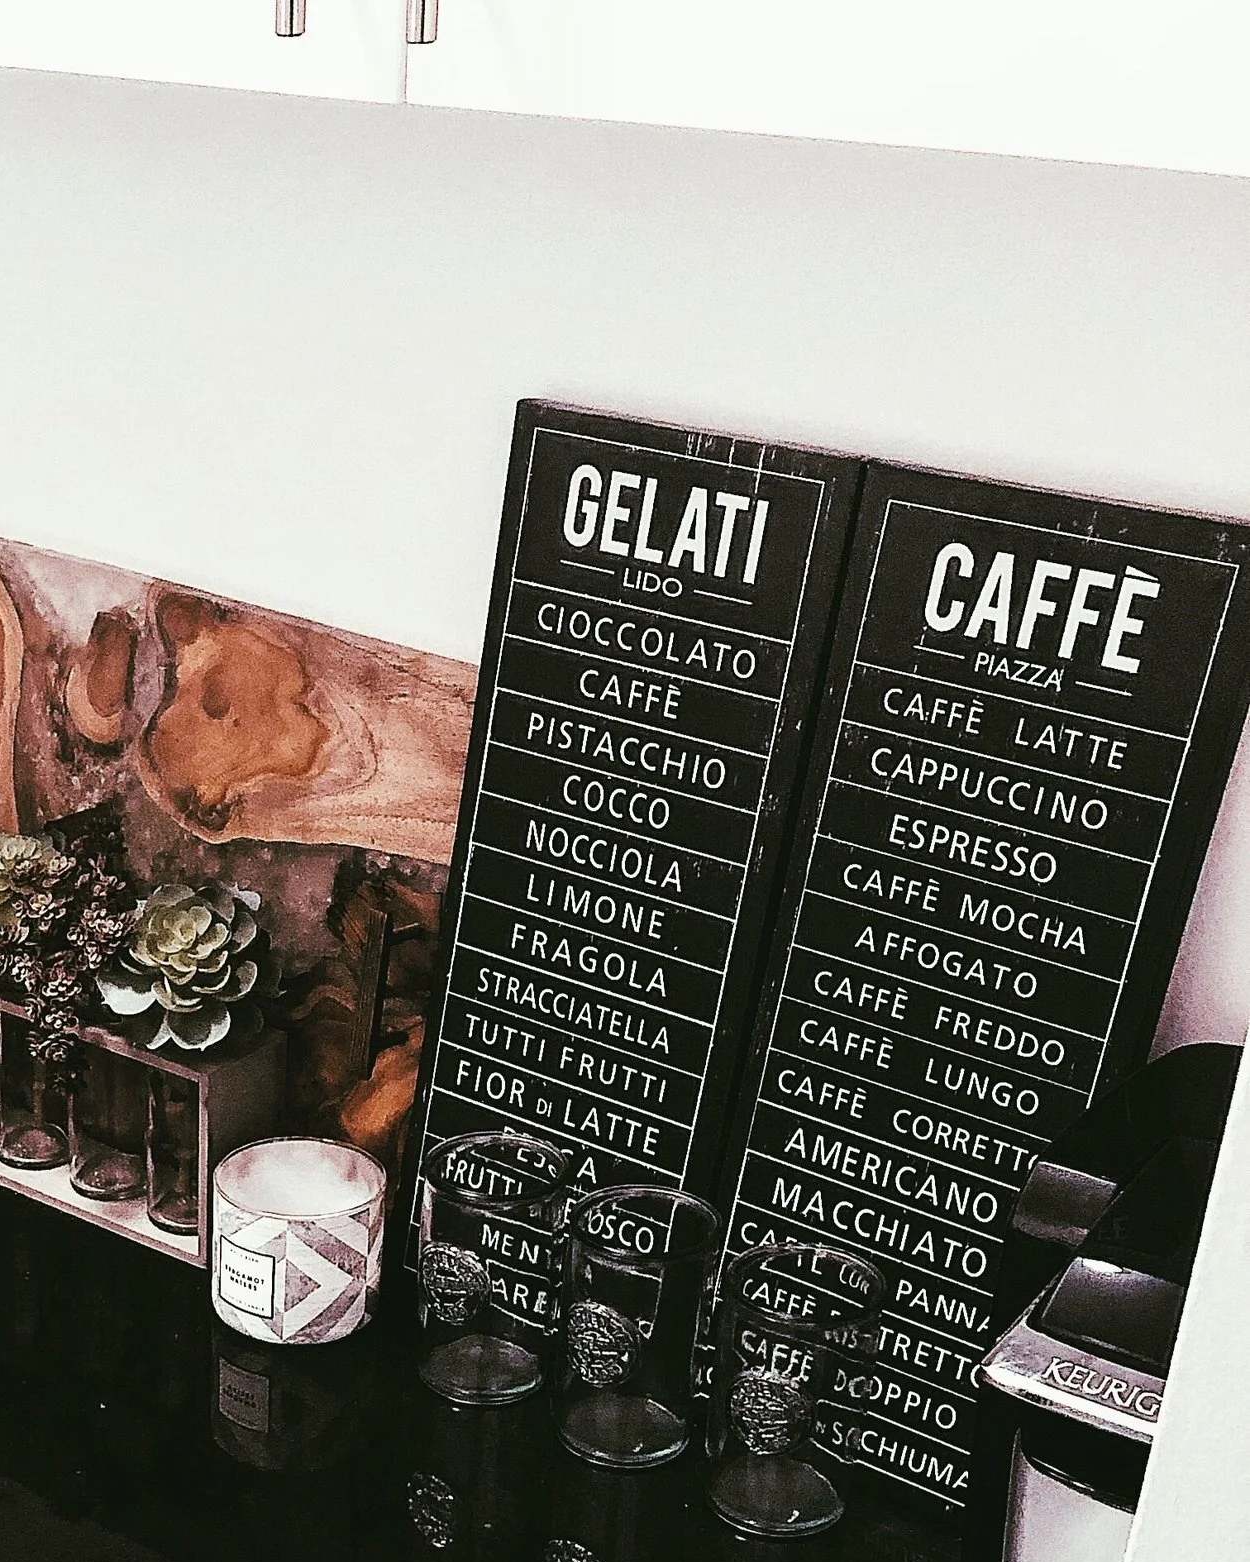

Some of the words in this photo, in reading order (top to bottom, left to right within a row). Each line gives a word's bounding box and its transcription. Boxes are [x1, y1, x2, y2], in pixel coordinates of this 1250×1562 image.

[562, 465, 769, 585] GELATI
[623, 568, 682, 597] LIDO
[924, 543, 1160, 674] CAFFÈ
[538, 603, 755, 678] CIOCCOLATO
[975, 652, 1064, 692] PIAZZA
[580, 670, 681, 719] CAFFÈ
[884, 689, 984, 734] CAFFÈ
[1015, 718, 1127, 769] LATTE
[527, 713, 725, 788] PISTACCHIO
[564, 775, 669, 829] COCCO
[871, 748, 1107, 829] CAPPUCCINO
[526, 820, 681, 892] NOCCIOLA
[889, 814, 1056, 884] ESPRESSO
[527, 874, 664, 939] LIMONE
[844, 864, 939, 911] CAFFÈ
[960, 894, 1085, 954] MOCHA
[511, 924, 666, 997] FRAGOLA
[855, 925, 1037, 998] AFFOGATO
[478, 967, 670, 1054] STRACCIATELLA
[815, 971, 908, 1020] CAFFÈ
[935, 1006, 1064, 1065] FREDDO
[464, 1013, 546, 1061] TUTTI
[560, 1047, 666, 1102] FRUTTI
[779, 1070, 866, 1118] CAFFÈ
[801, 1020, 893, 1068] CAFFÈ
[925, 1058, 1038, 1115] LUNGO
[457, 1060, 524, 1107] FIOR
[536, 1098, 552, 1117] DI
[564, 1099, 659, 1155] LATTE
[445, 1153, 522, 1196] FRUTTI
[784, 1127, 998, 1224] AMERICANO
[771, 1177, 987, 1278] MACCHIATO
[834, 1368, 956, 1429] DOPPIO
[1043, 1357, 1161, 1416] KEURIG
